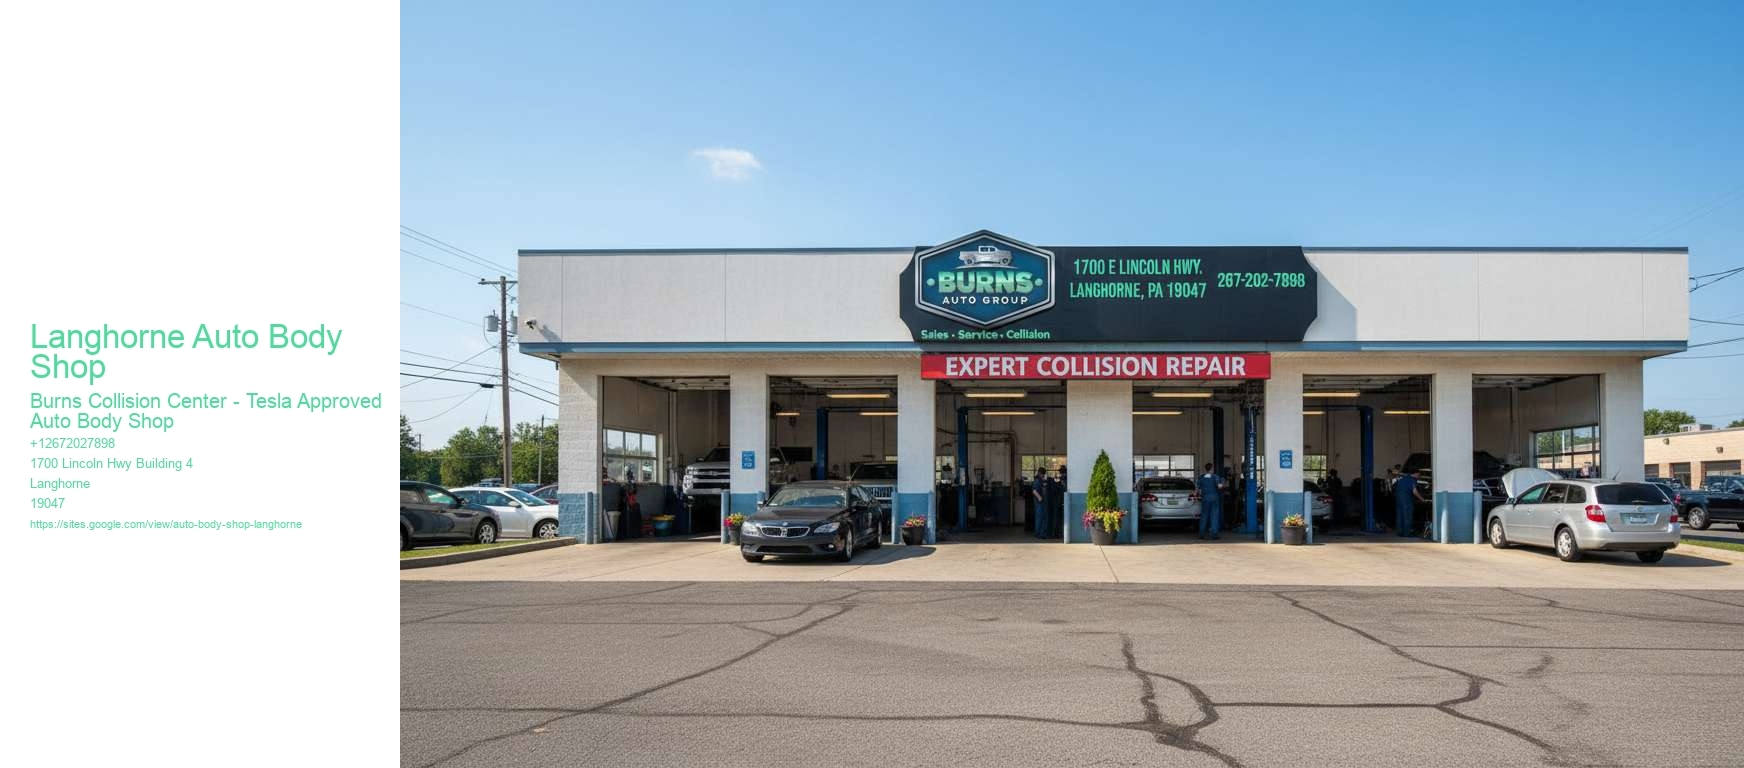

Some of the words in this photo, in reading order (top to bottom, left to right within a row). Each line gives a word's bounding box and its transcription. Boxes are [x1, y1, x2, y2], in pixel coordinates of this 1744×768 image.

[1073, 258, 1106, 275] 1700
[1108, 258, 1117, 275] E
[1119, 258, 1171, 275] LINCOLN
[1173, 258, 1203, 275] HWY.
[937, 270, 1034, 294] BURNS
[1069, 282, 1145, 300] LANGHORNE,
[1148, 282, 1164, 298] PA
[1167, 282, 1207, 299] 19047
[942, 296, 977, 305] AUTO
[982, 296, 1029, 305] GROUP
[920, 329, 949, 340] Sales
[945, 356, 1029, 377] EXPERT
[1036, 356, 1158, 377] COLLISION
[1166, 356, 1246, 377] REPAIR
